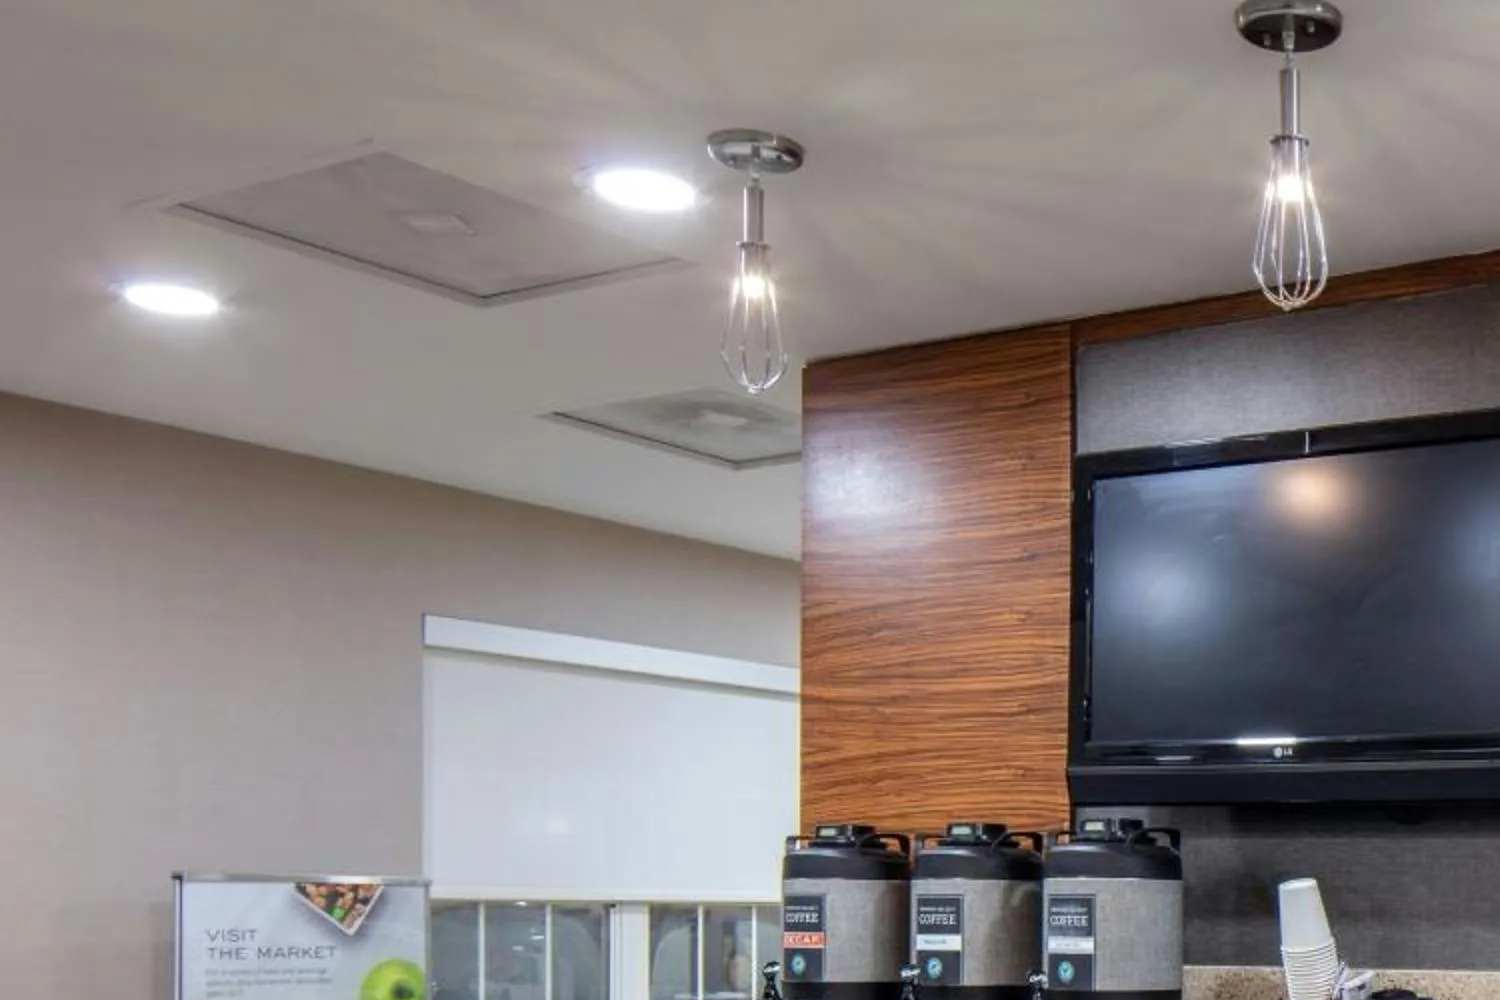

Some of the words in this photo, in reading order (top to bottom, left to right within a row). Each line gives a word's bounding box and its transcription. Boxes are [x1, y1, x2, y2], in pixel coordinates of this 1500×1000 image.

[785, 912, 819, 923] COFFEE
[919, 913, 957, 925] COFFEE
[1050, 915, 1089, 927] COFFEE
[205, 928, 257, 942] VISIT
[207, 947, 249, 961] THE
[256, 945, 337, 960] MARKET
